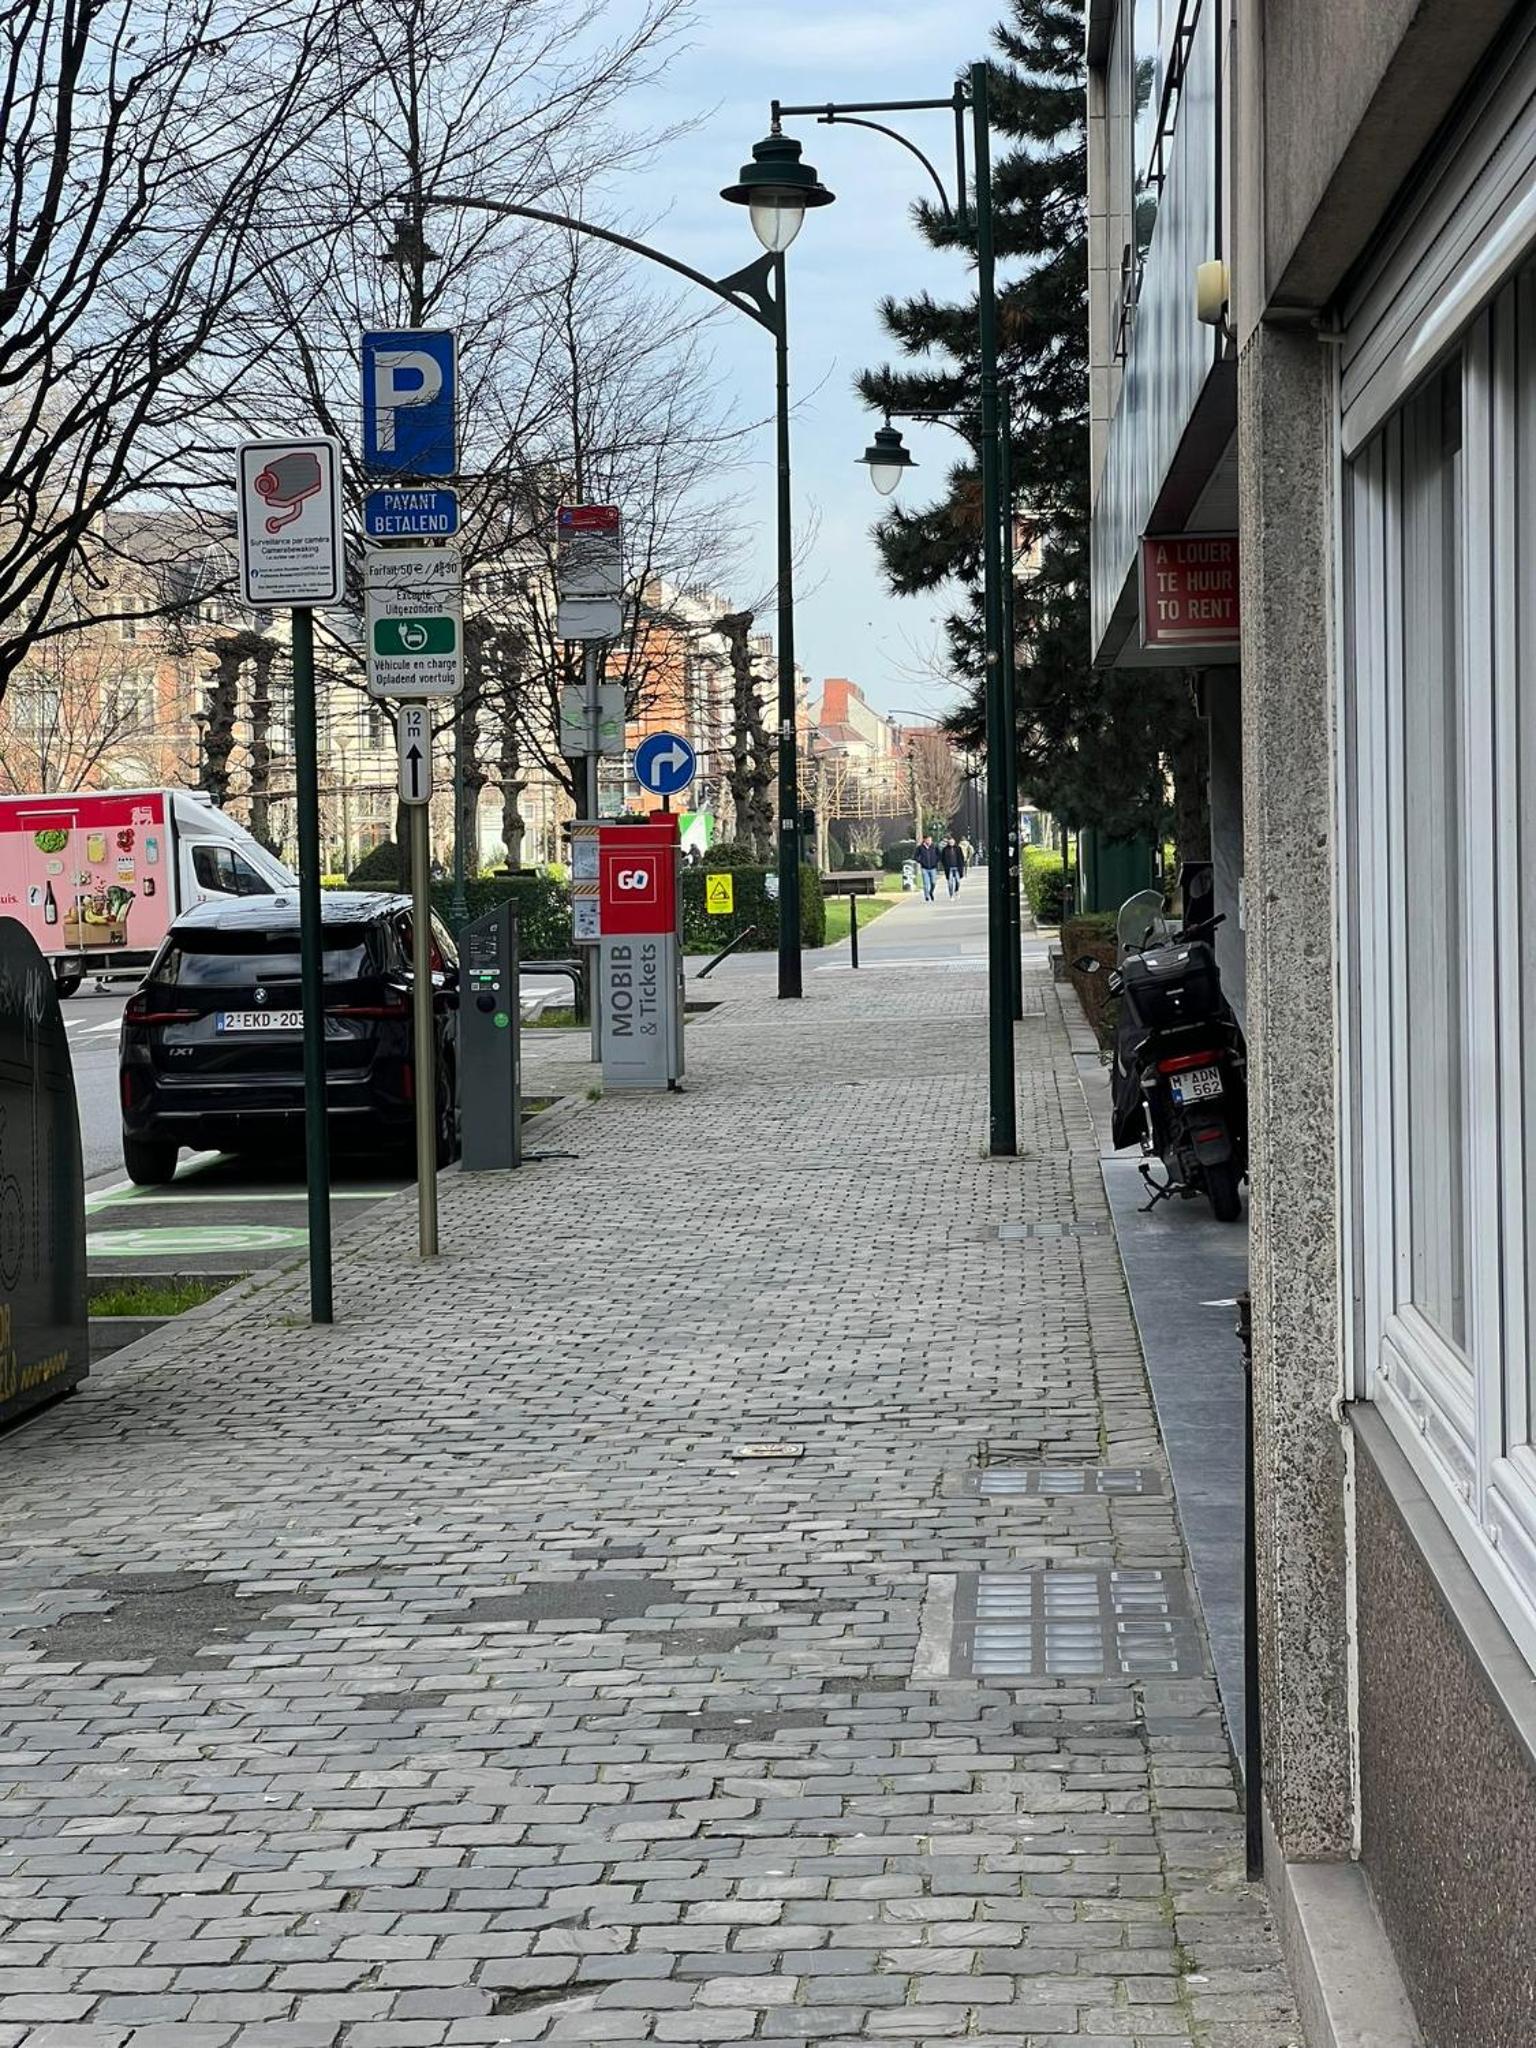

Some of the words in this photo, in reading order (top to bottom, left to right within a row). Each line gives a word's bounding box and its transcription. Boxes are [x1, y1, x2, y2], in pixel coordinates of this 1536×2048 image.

[373, 350, 443, 451] P
[384, 494, 437, 510] PAYANT
[375, 514, 448, 533] BETALEND
[1157, 545, 1168, 564] A
[1177, 543, 1231, 564] LOUER
[369, 564, 397, 576] Forfait
[1157, 572, 1179, 593] TE
[1187, 571, 1233, 592] HUUR
[385, 603, 444, 617] Uitgezonderd
[1157, 600, 1180, 621] TO
[1188, 599, 1233, 619] RENT
[374, 659, 411, 670] Véhicule
[413, 662, 424, 670] en
[427, 659, 457, 671] charge
[376, 673, 416, 686] Opladend
[419, 672, 456, 684] voertuig
[406, 711, 422, 725] 12
[407, 727, 421, 737] m
[618, 870, 649, 890] GO
[639, 943, 656, 1017] Tickets
[611, 945, 633, 1036] MOBIB
[640, 1024, 658, 1036] &
[1193, 1080, 1221, 1096] 562
